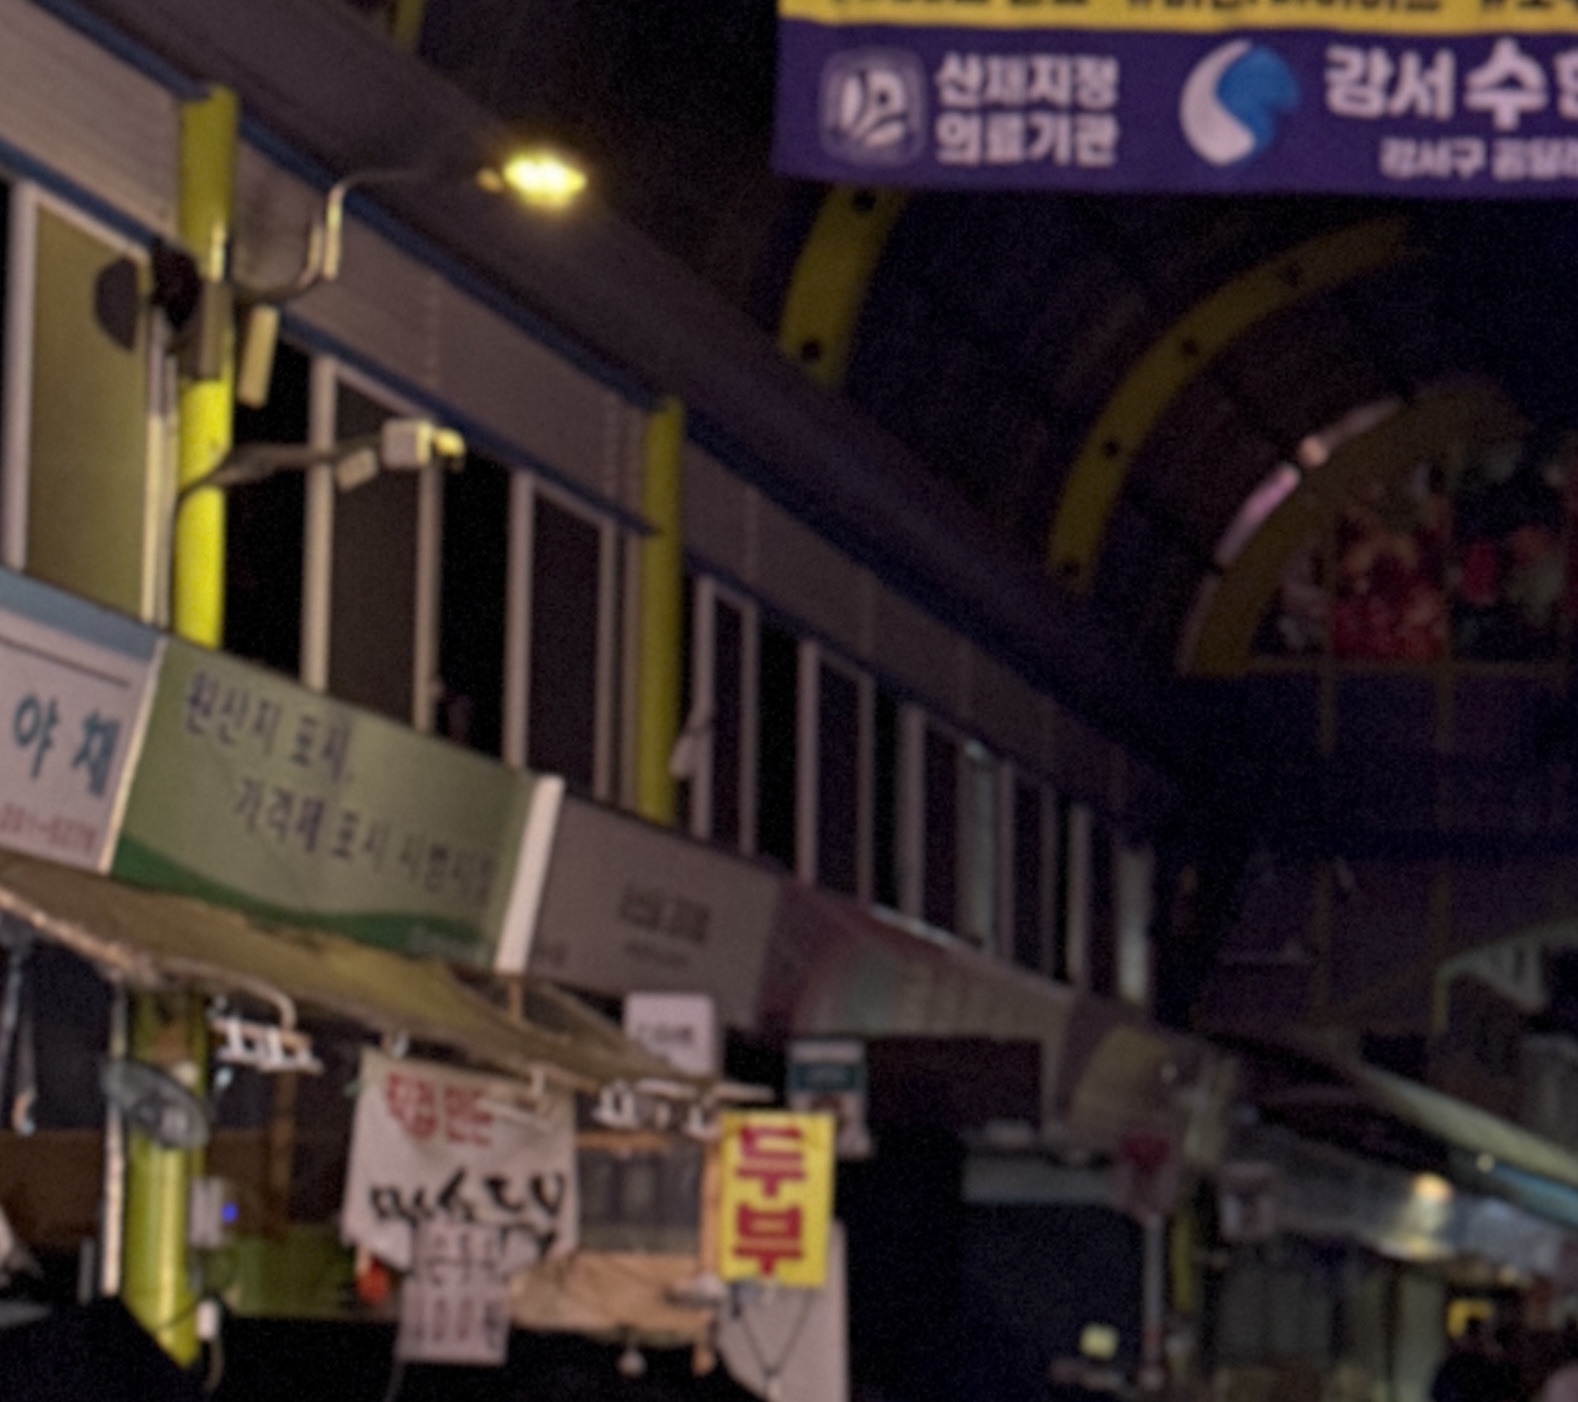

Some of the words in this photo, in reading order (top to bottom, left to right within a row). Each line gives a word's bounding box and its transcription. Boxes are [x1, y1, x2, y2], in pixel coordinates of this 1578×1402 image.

[185, 670, 281, 755] 원산지
[332, 808, 392, 876] 표시
[732, 1125, 806, 1278] 두부
